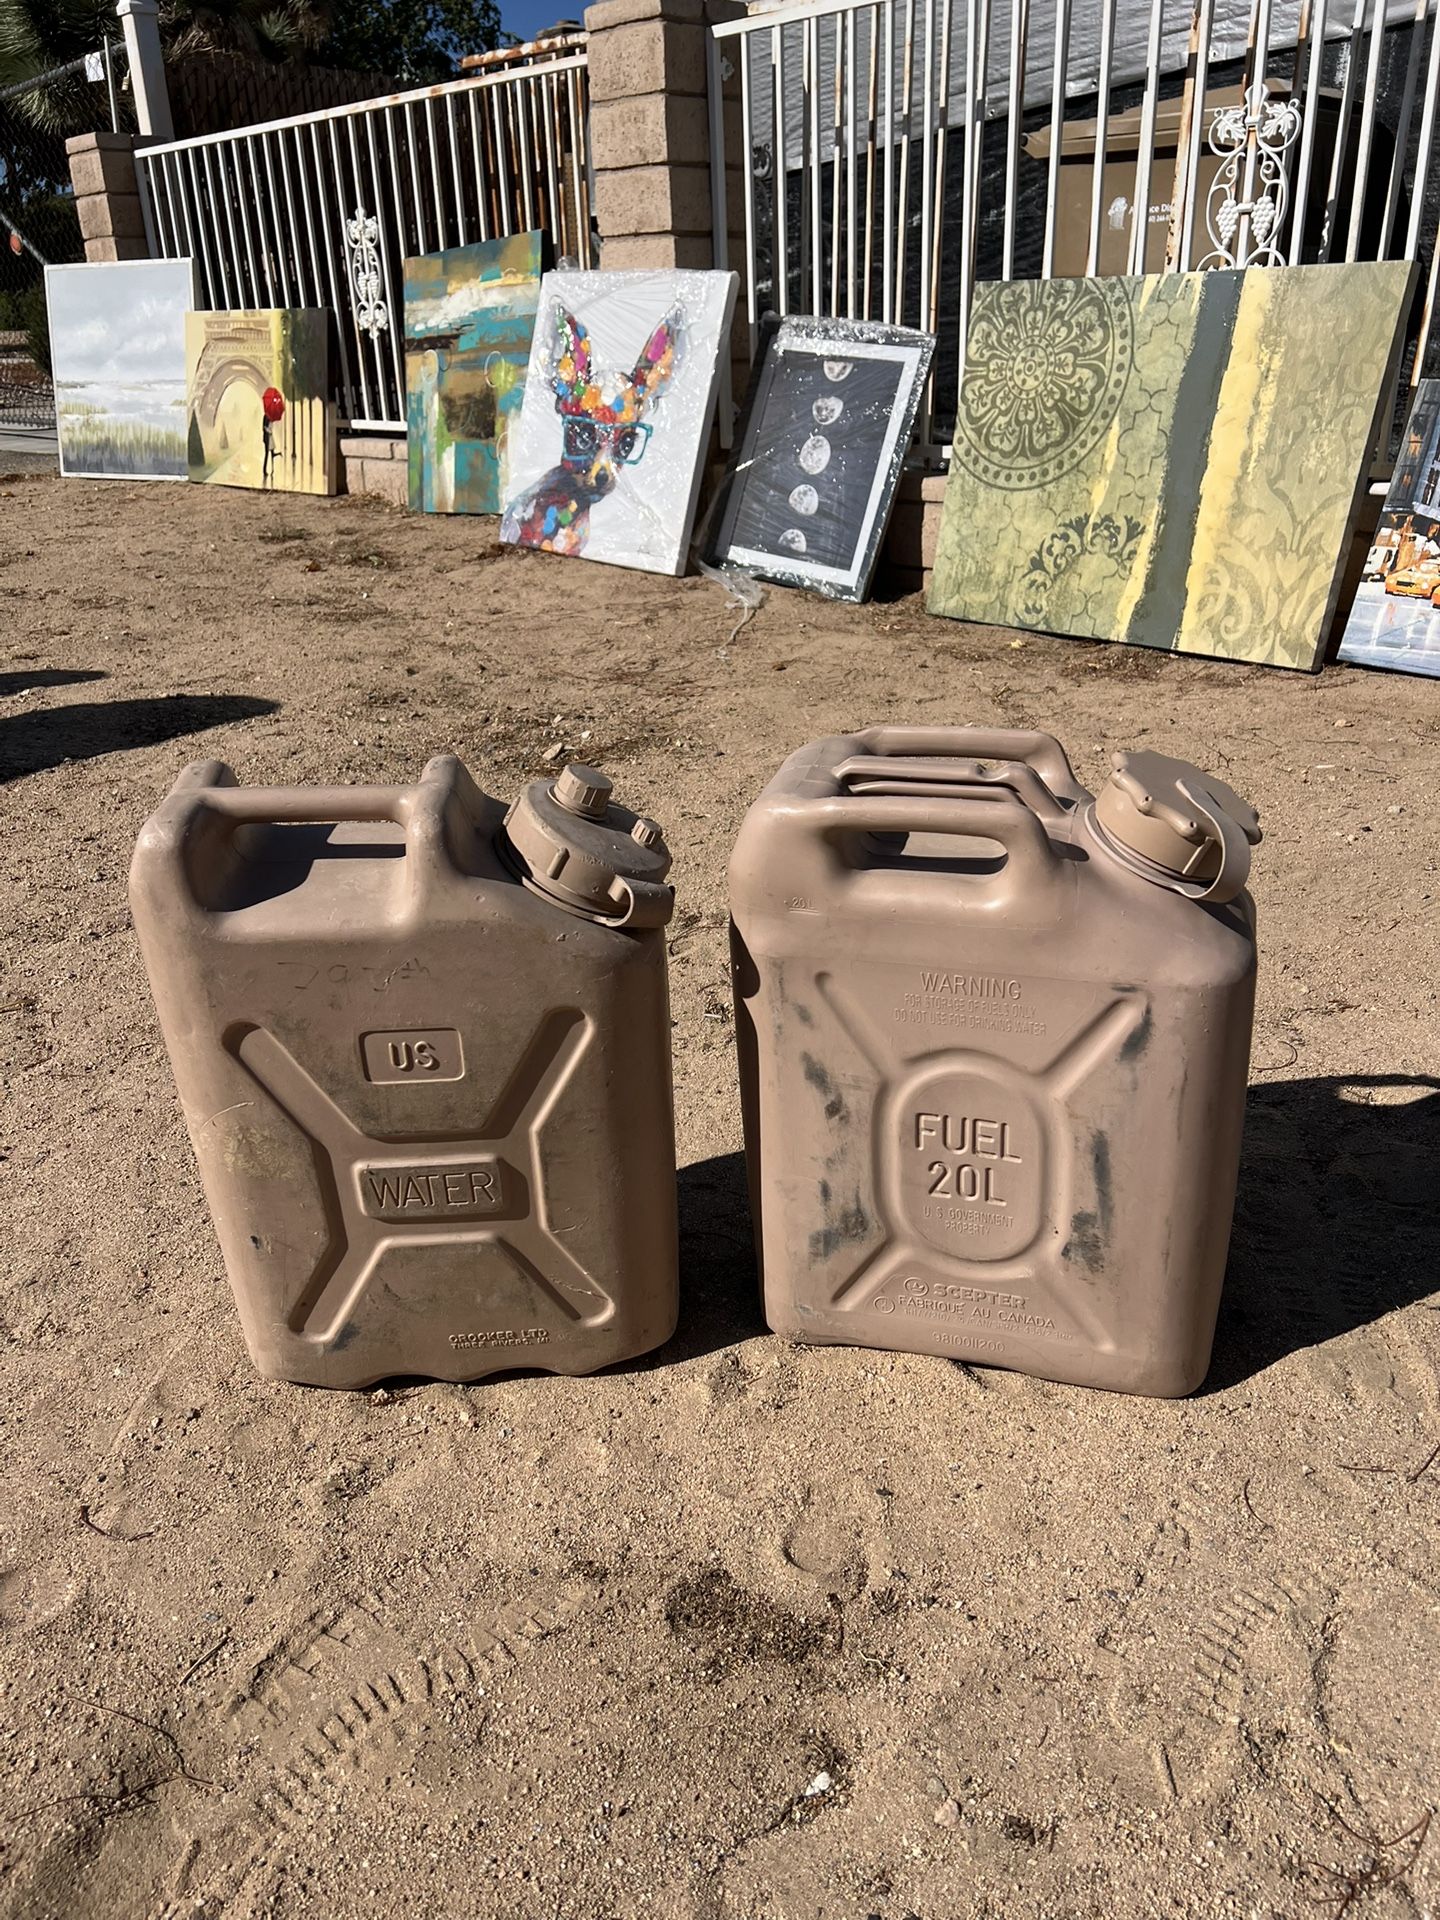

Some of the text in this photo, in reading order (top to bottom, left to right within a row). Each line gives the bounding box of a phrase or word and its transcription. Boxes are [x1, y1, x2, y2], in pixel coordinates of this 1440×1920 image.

[920, 971, 1022, 1001] WARNING
[894, 1008, 907, 1022] DO
[929, 1011, 947, 1026] USE
[949, 1013, 967, 1028] FOR
[904, 993, 1036, 1018] FOR STORAGE OF FUELS ONLY
[388, 1040, 441, 1072] US
[914, 1112, 1022, 1164] FUEL
[369, 1171, 496, 1209] WATER
[927, 1160, 1007, 1207] 20L
[944, 1220, 991, 1236] PROPERTY
[948, 1207, 1014, 1229] GOVERNMENT
[933, 1283, 1026, 1310] SCEPTER
[971, 1306, 992, 1319] AU
[998, 1310, 1056, 1330] CANADA
[520, 1328, 549, 1338] LTD
